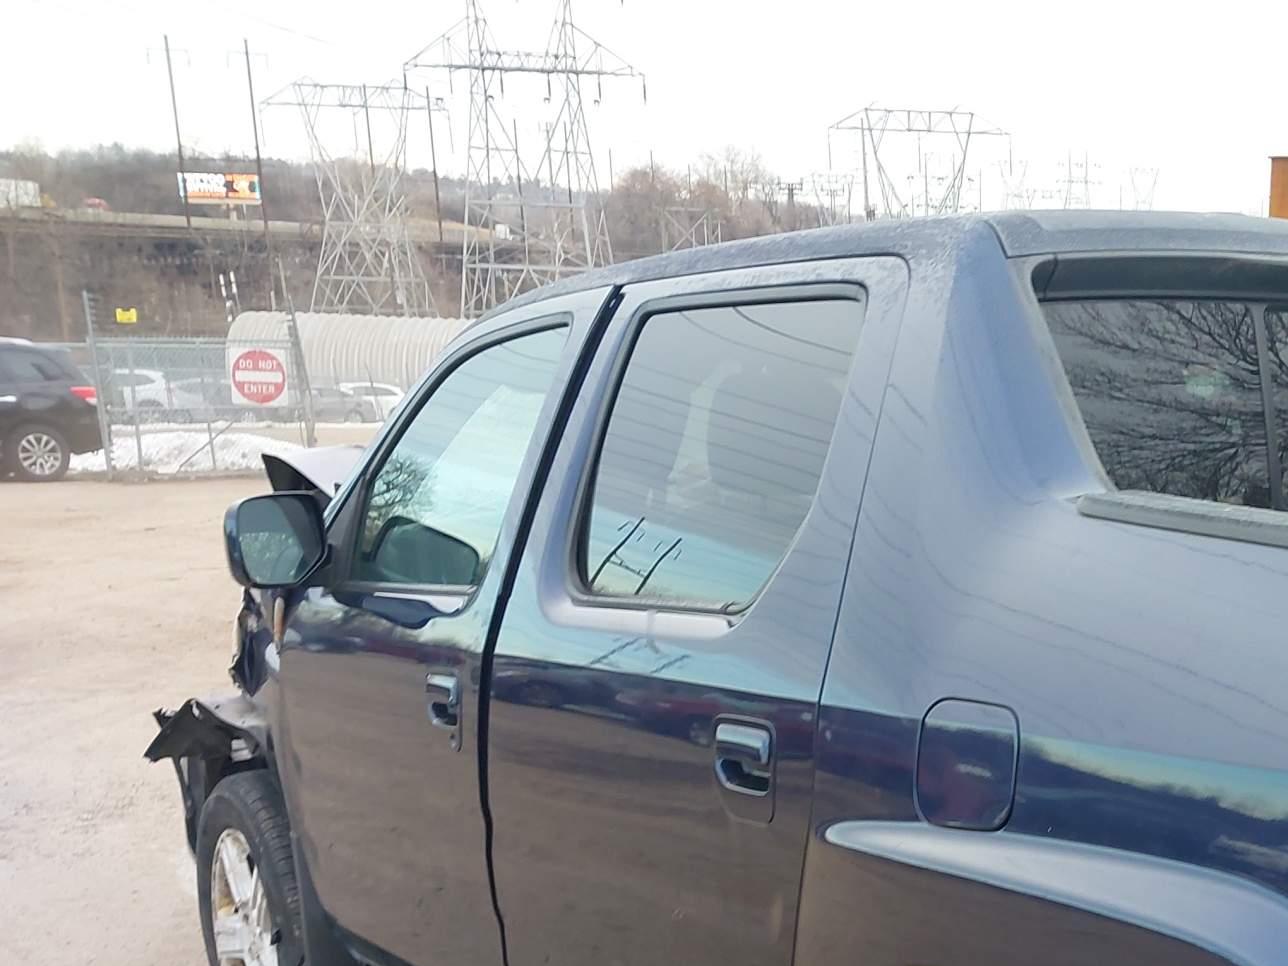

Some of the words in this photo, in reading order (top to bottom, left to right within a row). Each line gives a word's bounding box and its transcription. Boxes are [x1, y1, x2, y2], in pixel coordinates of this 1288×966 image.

[239, 359, 253, 369] DO
[259, 359, 276, 370] NOT
[244, 383, 275, 393] ENTER
